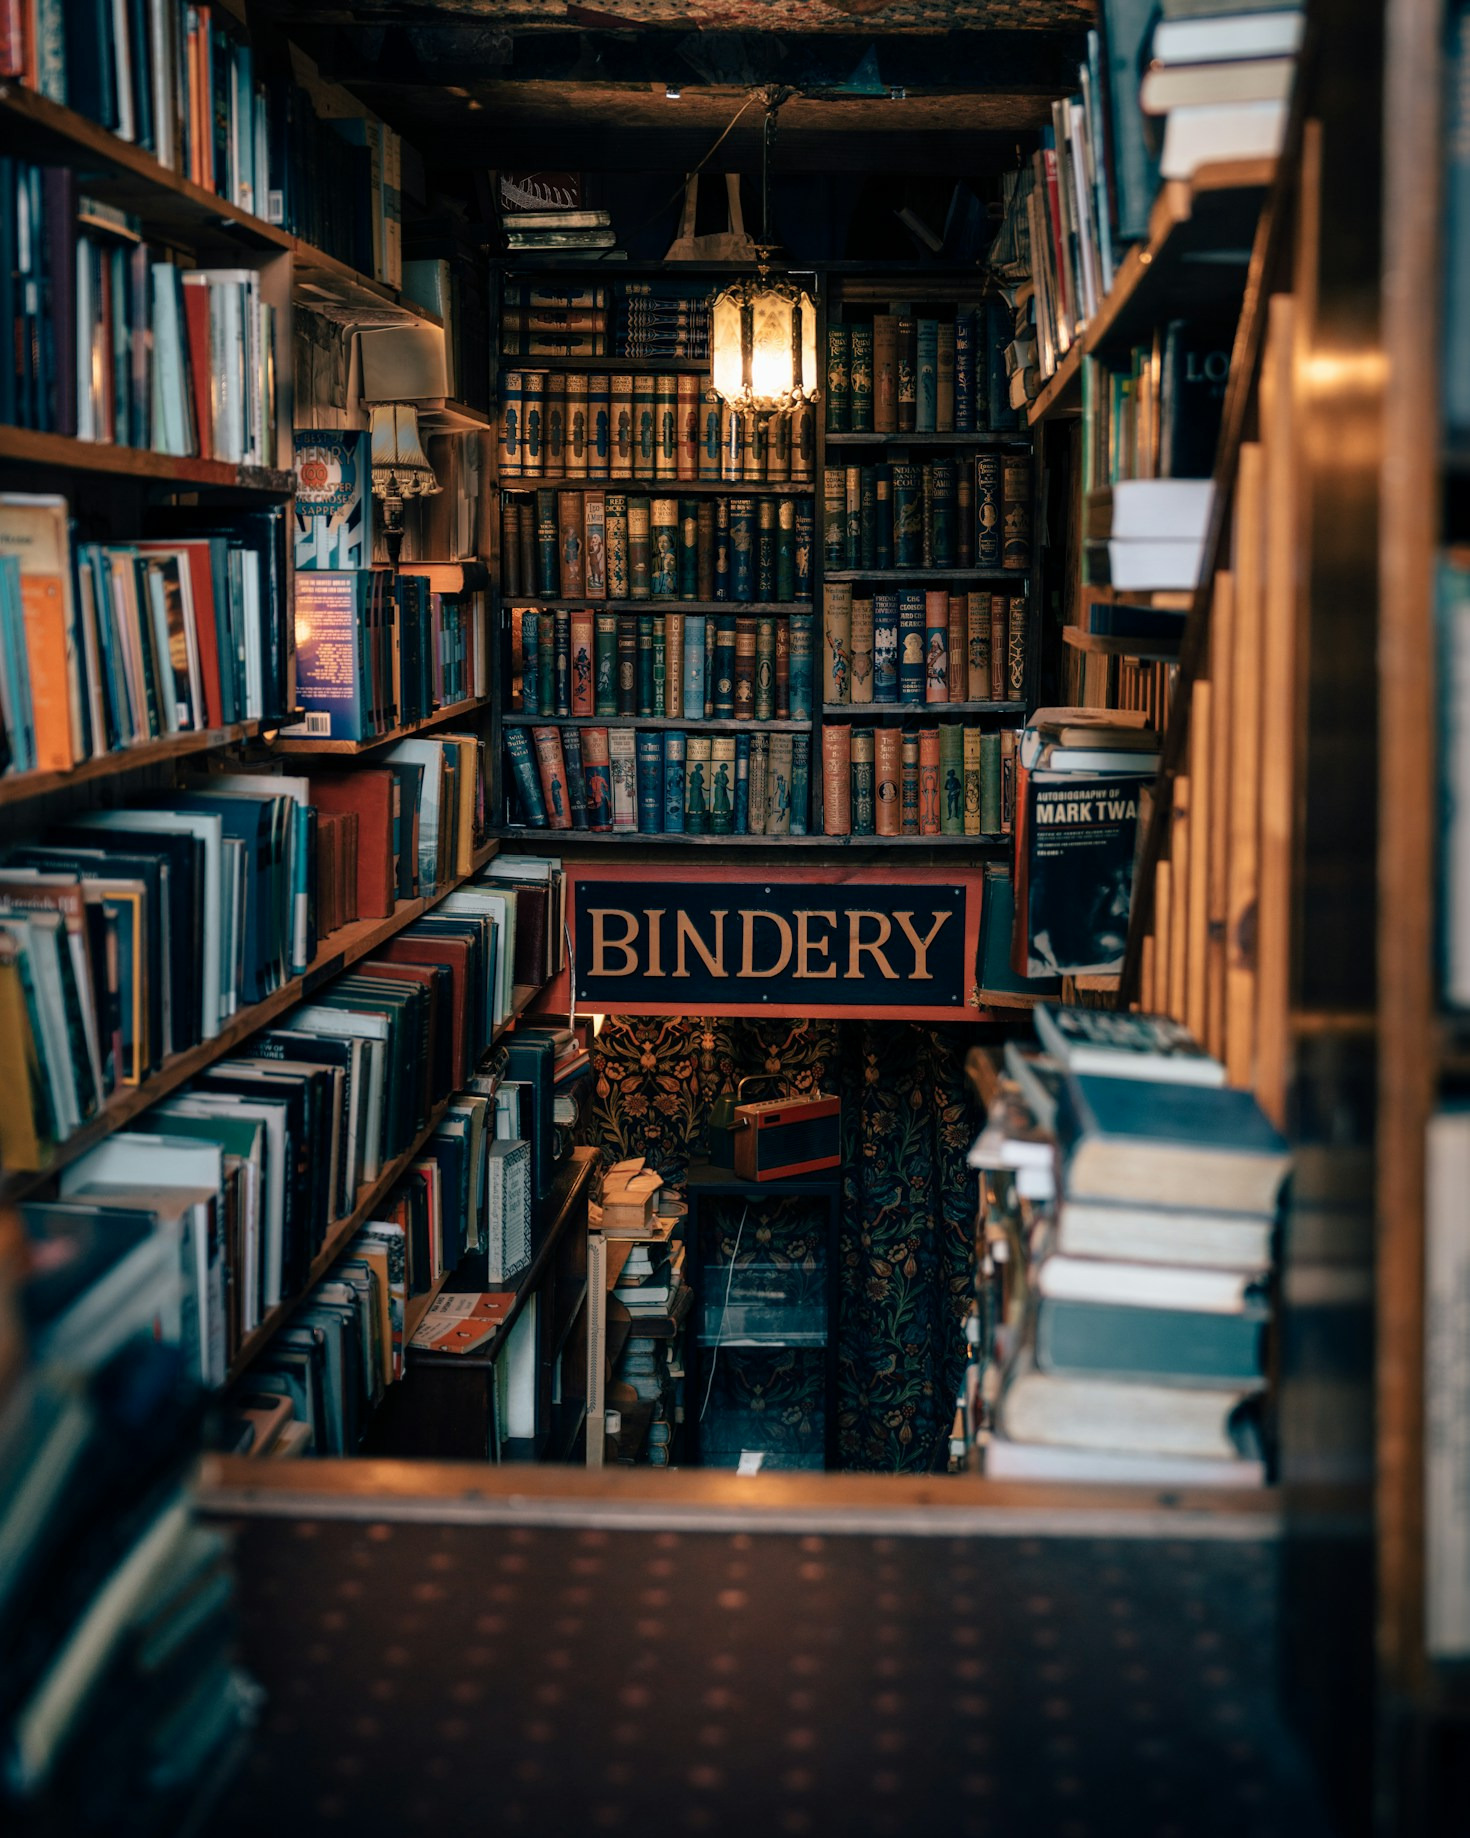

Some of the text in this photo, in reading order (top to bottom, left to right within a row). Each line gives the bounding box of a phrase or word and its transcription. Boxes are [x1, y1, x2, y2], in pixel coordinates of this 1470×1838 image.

[302, 506, 344, 516] SAPPER
[507, 741, 528, 749] Buller
[1036, 788, 1120, 801] AUTOBIOGRAPHY OF
[1036, 802, 1092, 824] MARK
[586, 907, 953, 981] BINDERY
